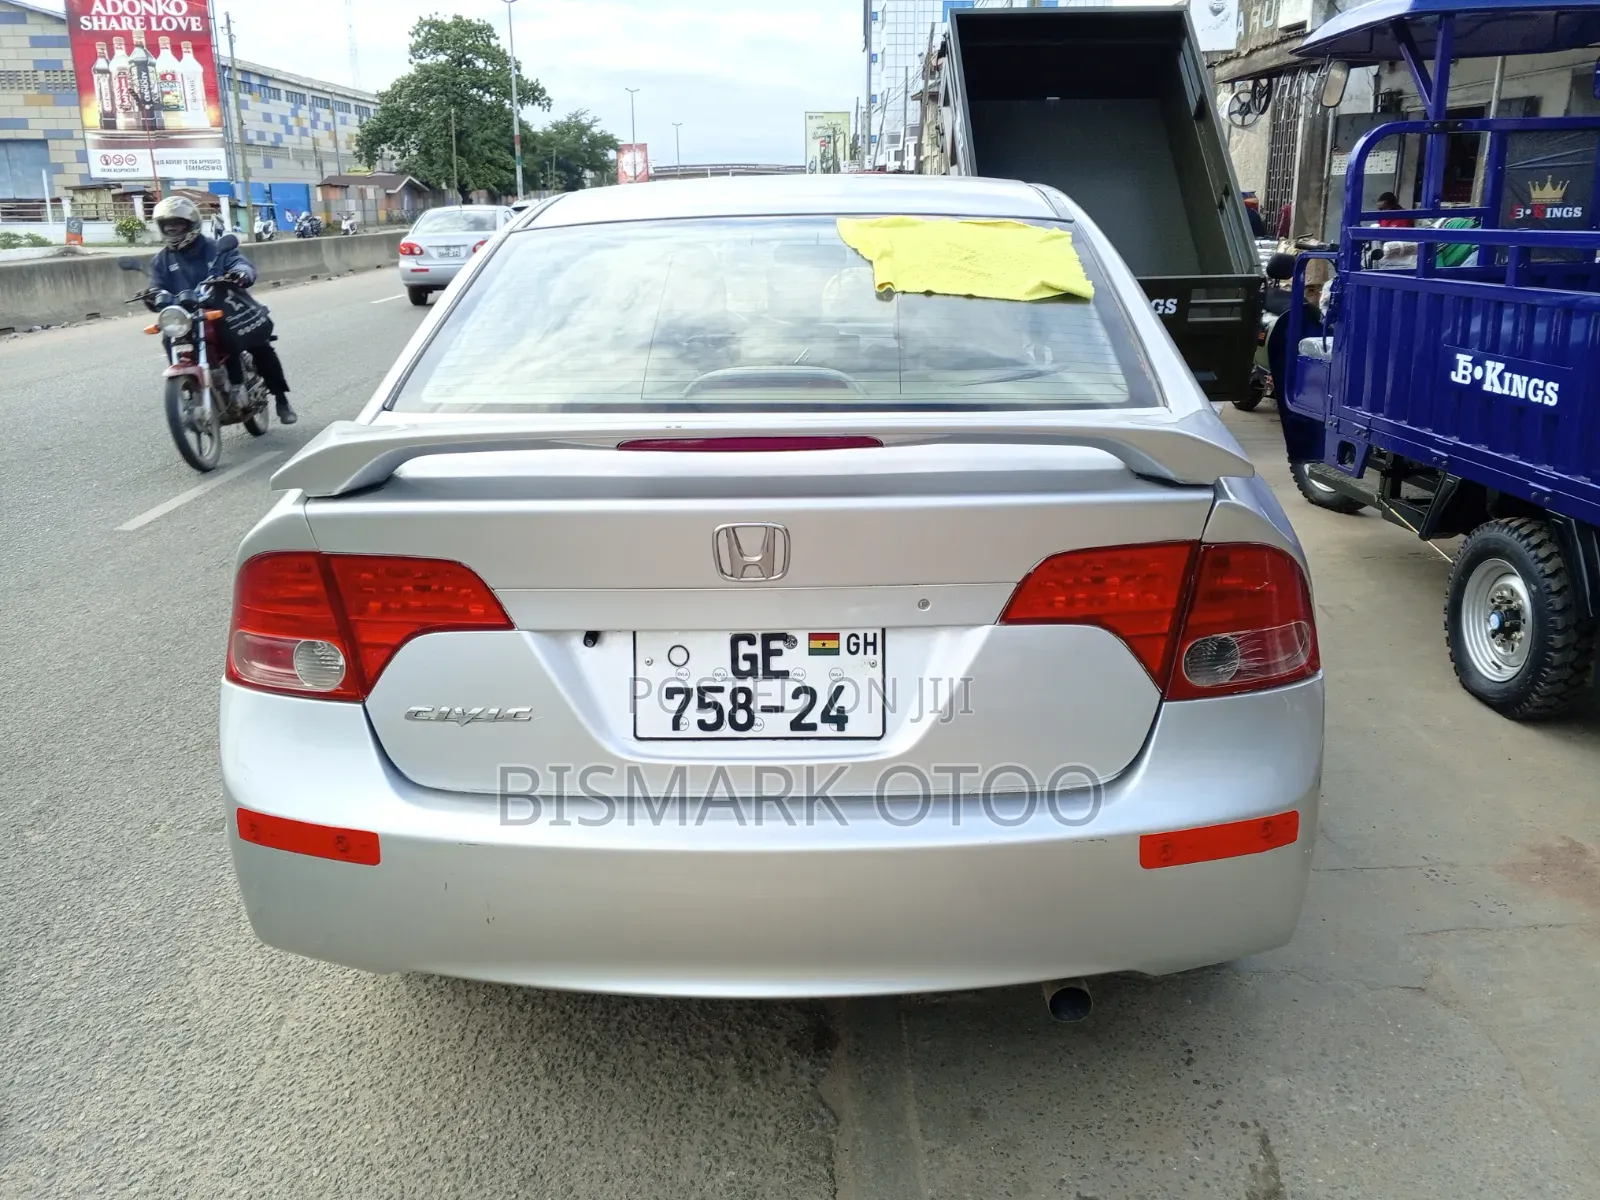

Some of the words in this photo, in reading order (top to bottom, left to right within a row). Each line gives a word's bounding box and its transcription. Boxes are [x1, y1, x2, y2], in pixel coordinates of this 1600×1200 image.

[90, 0, 188, 16] ADONKO
[79, 16, 147, 31] SHARE
[150, 16, 204, 32] LOVE
[845, 633, 878, 656] GH
[729, 632, 790, 680] GE
[404, 706, 534, 727] CIVIC
[665, 684, 849, 732] 758-24
